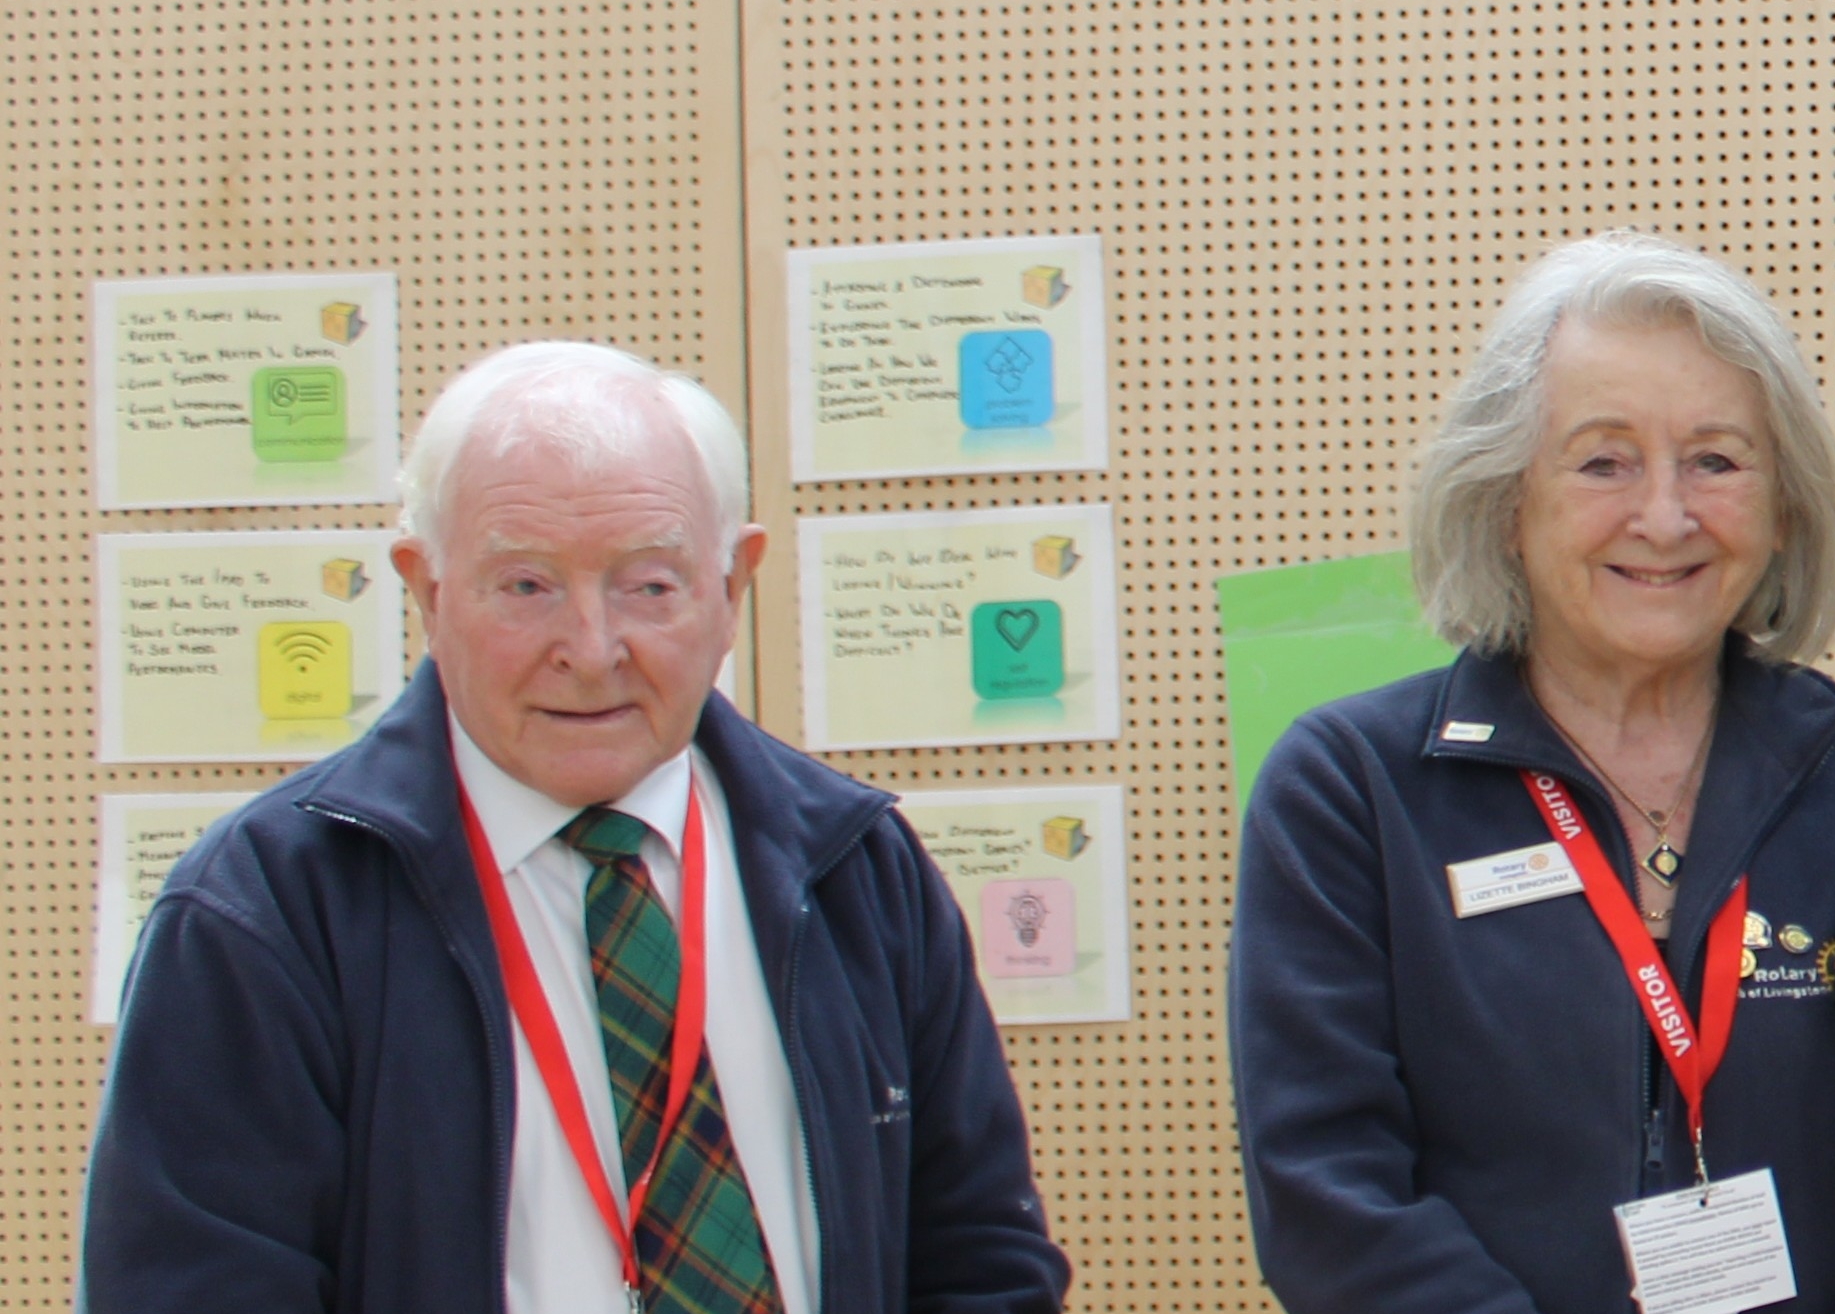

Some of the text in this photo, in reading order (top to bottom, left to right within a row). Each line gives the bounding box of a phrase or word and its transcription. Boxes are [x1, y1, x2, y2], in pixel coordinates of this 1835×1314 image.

[1530, 771, 1582, 840] VISITO
[1755, 965, 1817, 982] Rotary
[1638, 964, 1691, 1057] VISITOR
